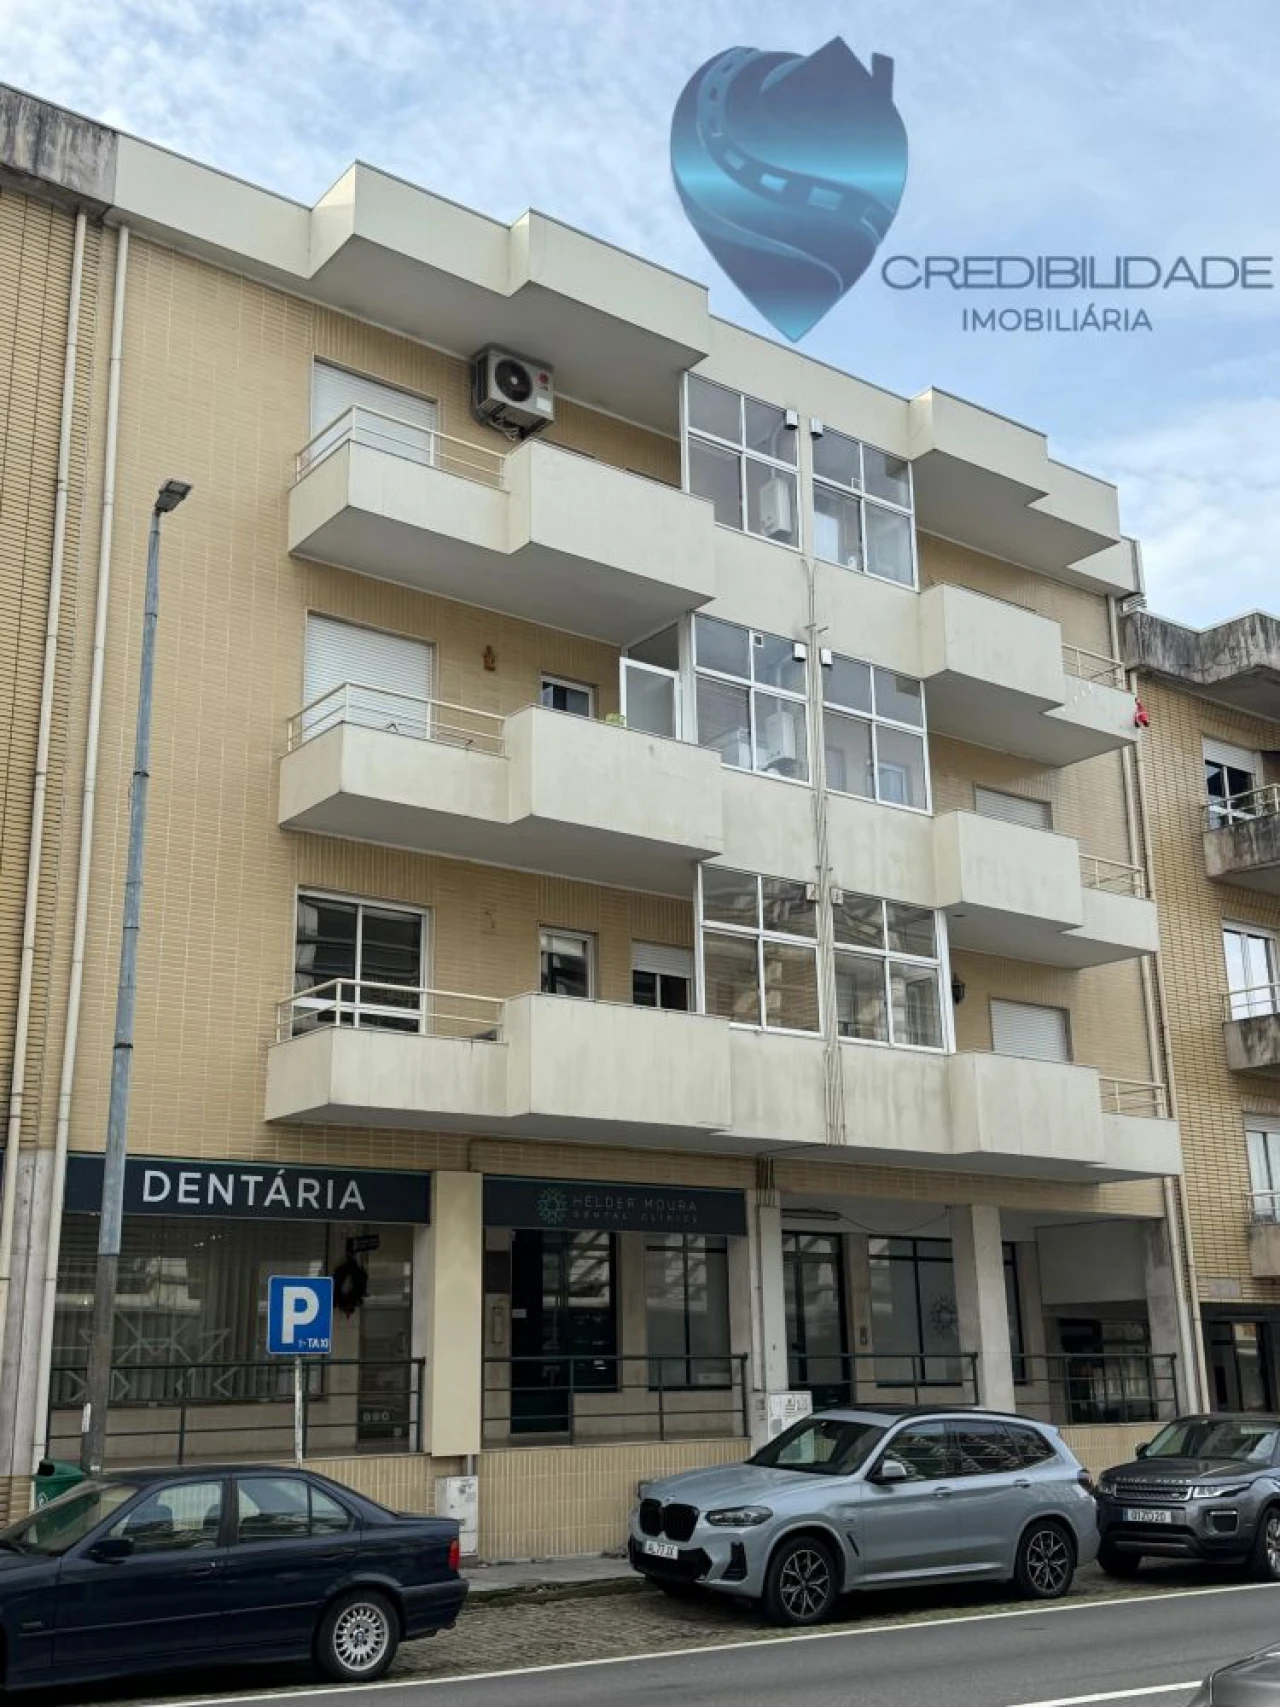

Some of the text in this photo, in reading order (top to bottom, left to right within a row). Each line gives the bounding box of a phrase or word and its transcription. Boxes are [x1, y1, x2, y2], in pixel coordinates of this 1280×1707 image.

[142, 1168, 366, 1211] DENTÁRIA
[644, 1198, 697, 1211] MOURA
[281, 1286, 319, 1344] P
